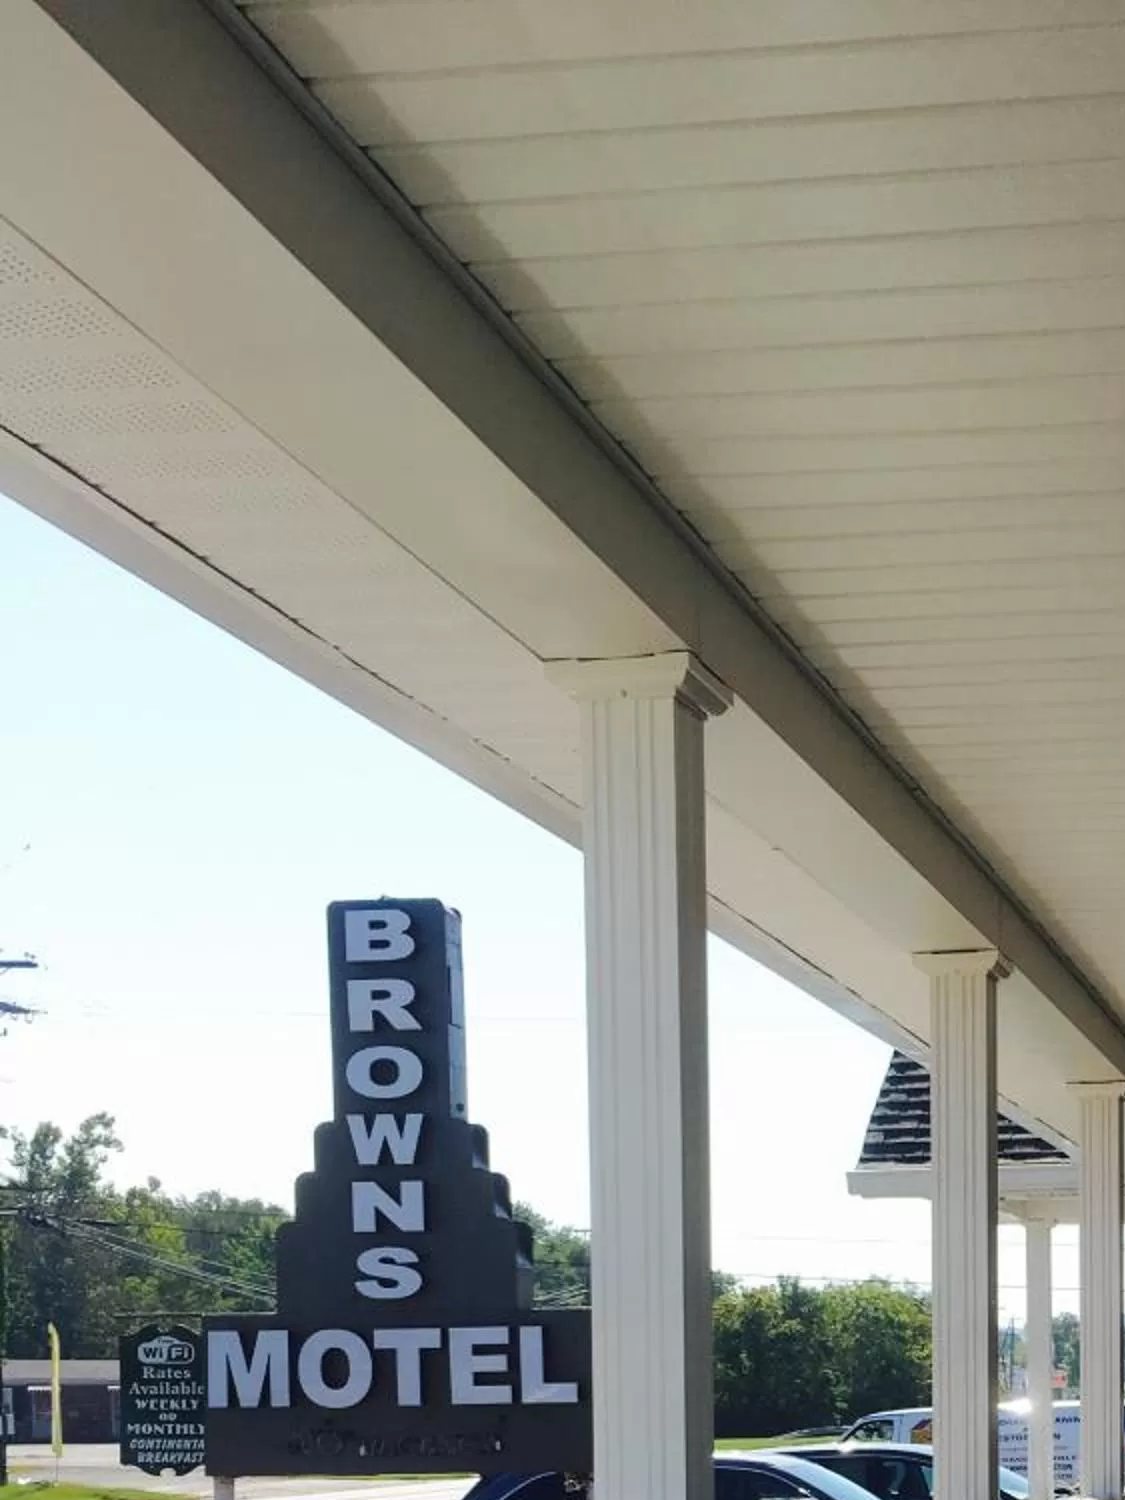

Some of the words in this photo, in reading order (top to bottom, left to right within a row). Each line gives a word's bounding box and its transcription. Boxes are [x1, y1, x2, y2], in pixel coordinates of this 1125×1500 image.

[344, 909, 424, 1299] BROWNS
[143, 1366, 191, 1379] Rates
[207, 1325, 578, 1409] MOTEL
[129, 1381, 205, 1395] Available
[135, 1399, 198, 1411] WEEKLY
[130, 1439, 205, 1450] CONTINENTA
